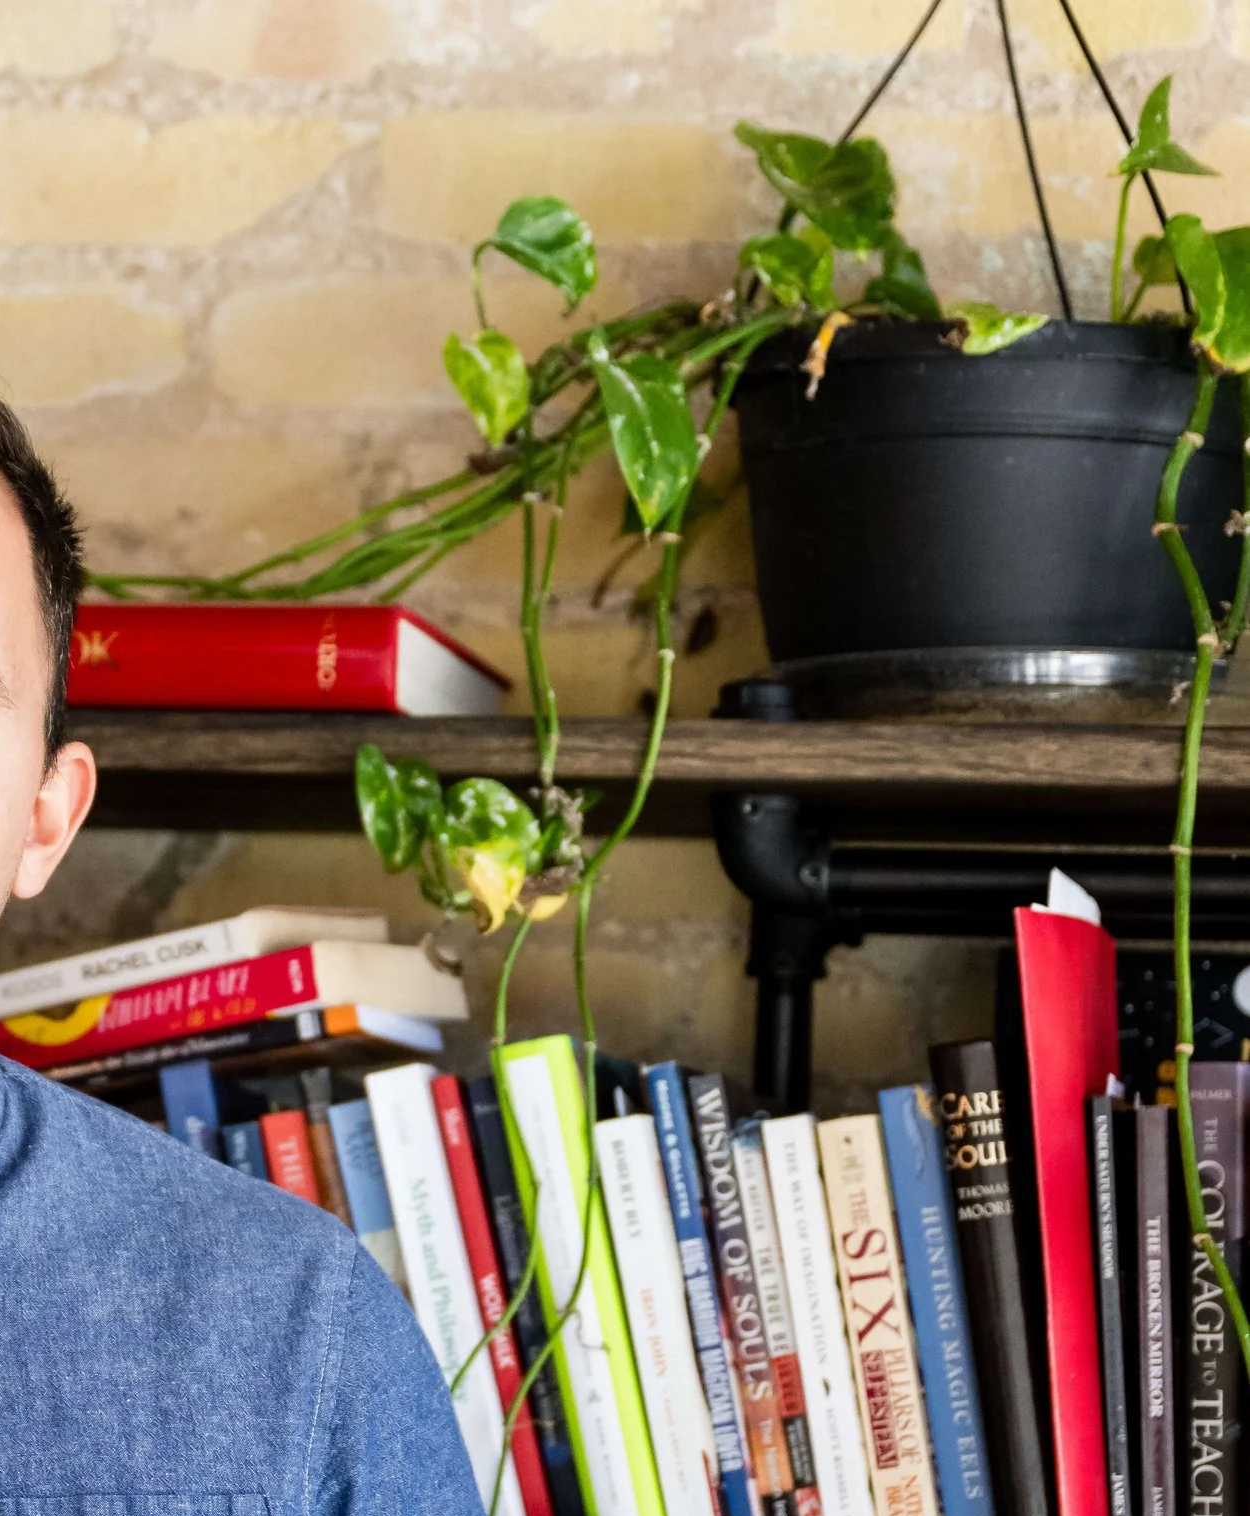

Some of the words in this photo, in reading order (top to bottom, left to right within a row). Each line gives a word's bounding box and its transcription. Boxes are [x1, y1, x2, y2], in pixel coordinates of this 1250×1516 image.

[79, 947, 152, 982] RACHEL
[155, 934, 207, 963] CUSK
[654, 1078, 676, 1128] MOORE
[942, 1090, 1004, 1118] CARE
[969, 1118, 1003, 1136] THE
[691, 1087, 744, 1230] WISDOM
[783, 1141, 800, 1174] THE
[1095, 1114, 1110, 1157] UNDER
[1201, 1117, 1218, 1153] THE
[277, 1136, 306, 1190] THE
[609, 1138, 636, 1206] ROBERT
[667, 1148, 693, 1219] GILLETTE
[788, 1179, 806, 1217] WAY
[847, 1191, 869, 1224] THE
[957, 1181, 1009, 1199] THOMAS
[957, 1199, 1013, 1220] MOORE
[1097, 1162, 1112, 1222] SATURN'S
[402, 1175, 436, 1232] Myth
[420, 1237, 447, 1281] and
[623, 1208, 643, 1241] BLY
[795, 1222, 811, 1244] OF
[1146, 1216, 1162, 1254] THE
[678, 1236, 708, 1275] KING
[718, 1235, 754, 1290] OF
[754, 1246, 776, 1279] THE
[1100, 1226, 1113, 1280] SHADOW
[1190, 1159, 1224, 1353] COURAGE
[639, 1287, 659, 1329] IRON
[799, 1249, 830, 1366] IMAGINATION
[839, 1225, 901, 1345] SIX
[1146, 1258, 1163, 1337] BROKEN
[685, 1274, 721, 1348] WARRIOR
[761, 1284, 786, 1336] TRUE
[648, 1334, 669, 1378] JOHN
[728, 1293, 775, 1403] SOULS
[919, 1204, 958, 1331] HUNTING
[941, 1339, 973, 1427] MAGIC
[957, 1435, 985, 1502] EELS
[1201, 1358, 1216, 1385] TO
[699, 1347, 735, 1425] MAGICIAN
[769, 1338, 798, 1417] BELIEVER
[883, 1346, 915, 1428] PILLARS
[1147, 1341, 1164, 1418] MIRROR
[714, 1424, 745, 1474] LOVER
[758, 1418, 776, 1448] The
[824, 1406, 842, 1447] SCOTT
[896, 1431, 921, 1468] OF
[763, 1449, 785, 1496] Newton
[831, 1450, 851, 1509] RUSSELL
[1110, 1472, 1124, 1513] JAMES
